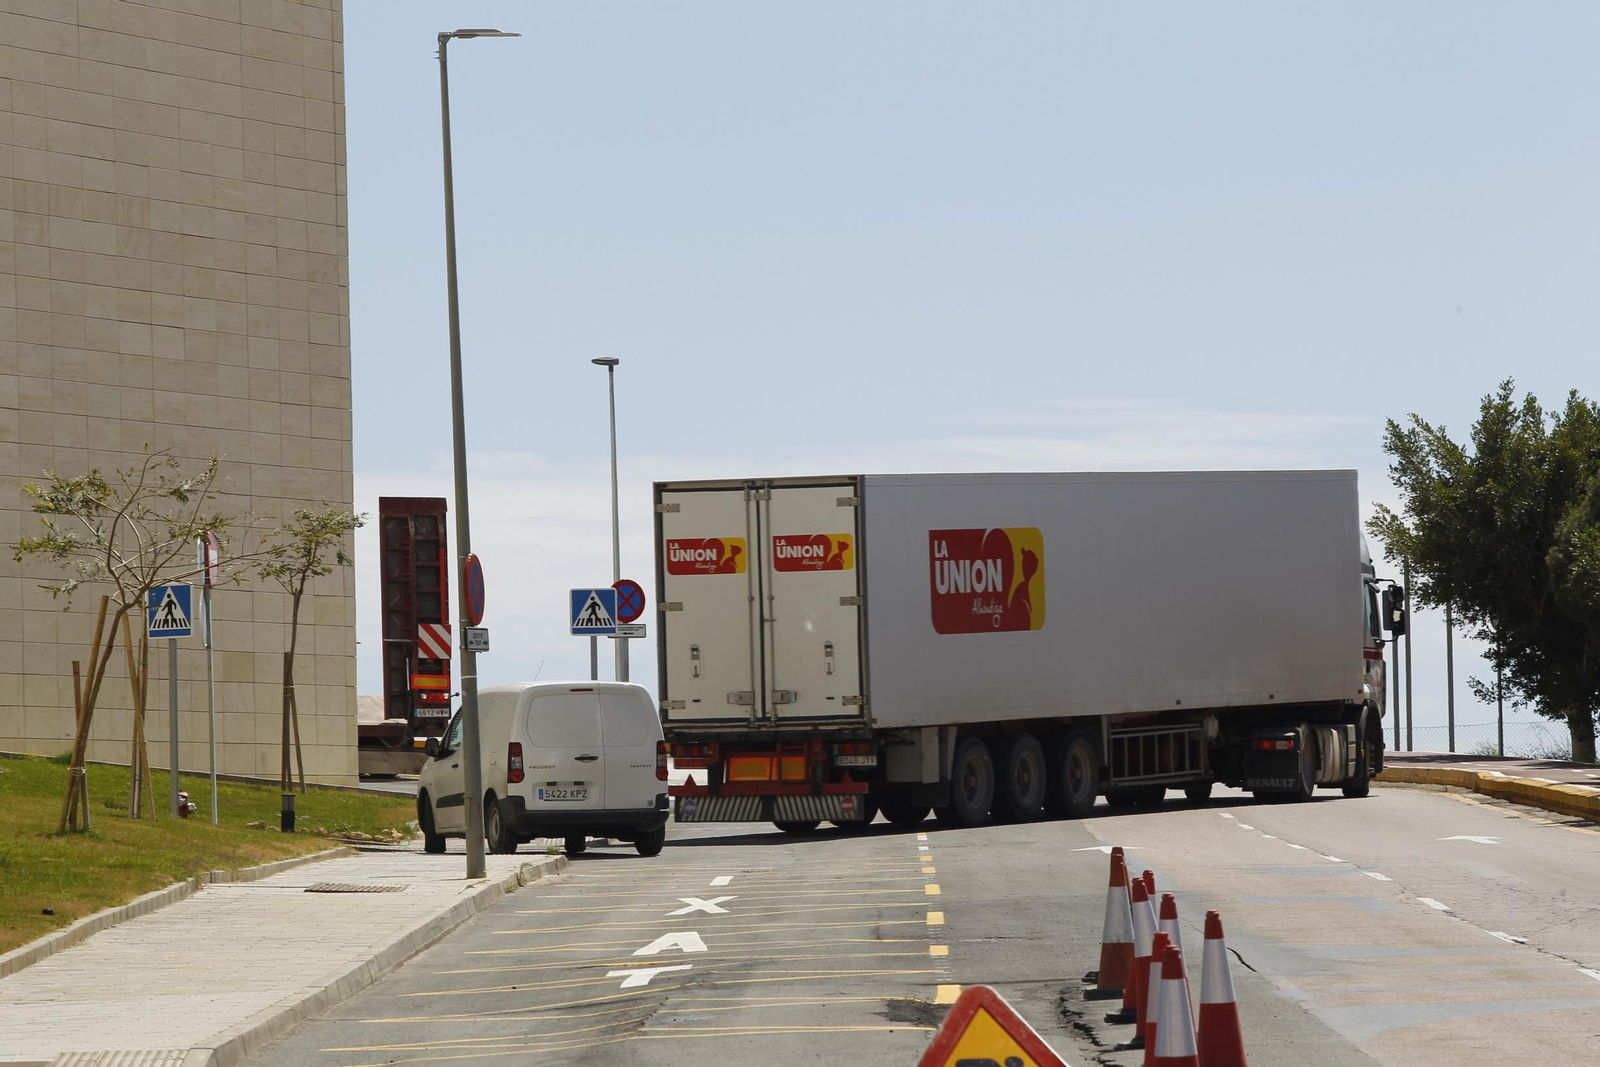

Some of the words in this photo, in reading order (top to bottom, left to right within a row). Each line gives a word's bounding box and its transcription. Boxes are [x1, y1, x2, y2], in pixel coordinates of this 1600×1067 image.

[669, 548, 717, 562] UNION
[776, 545, 824, 559] UNION
[934, 540, 949, 558] LA
[935, 559, 1003, 595] UNION
[1246, 778, 1295, 788] RENAULT
[545, 789, 568, 799] 5422
[570, 789, 588, 799] KPZ
